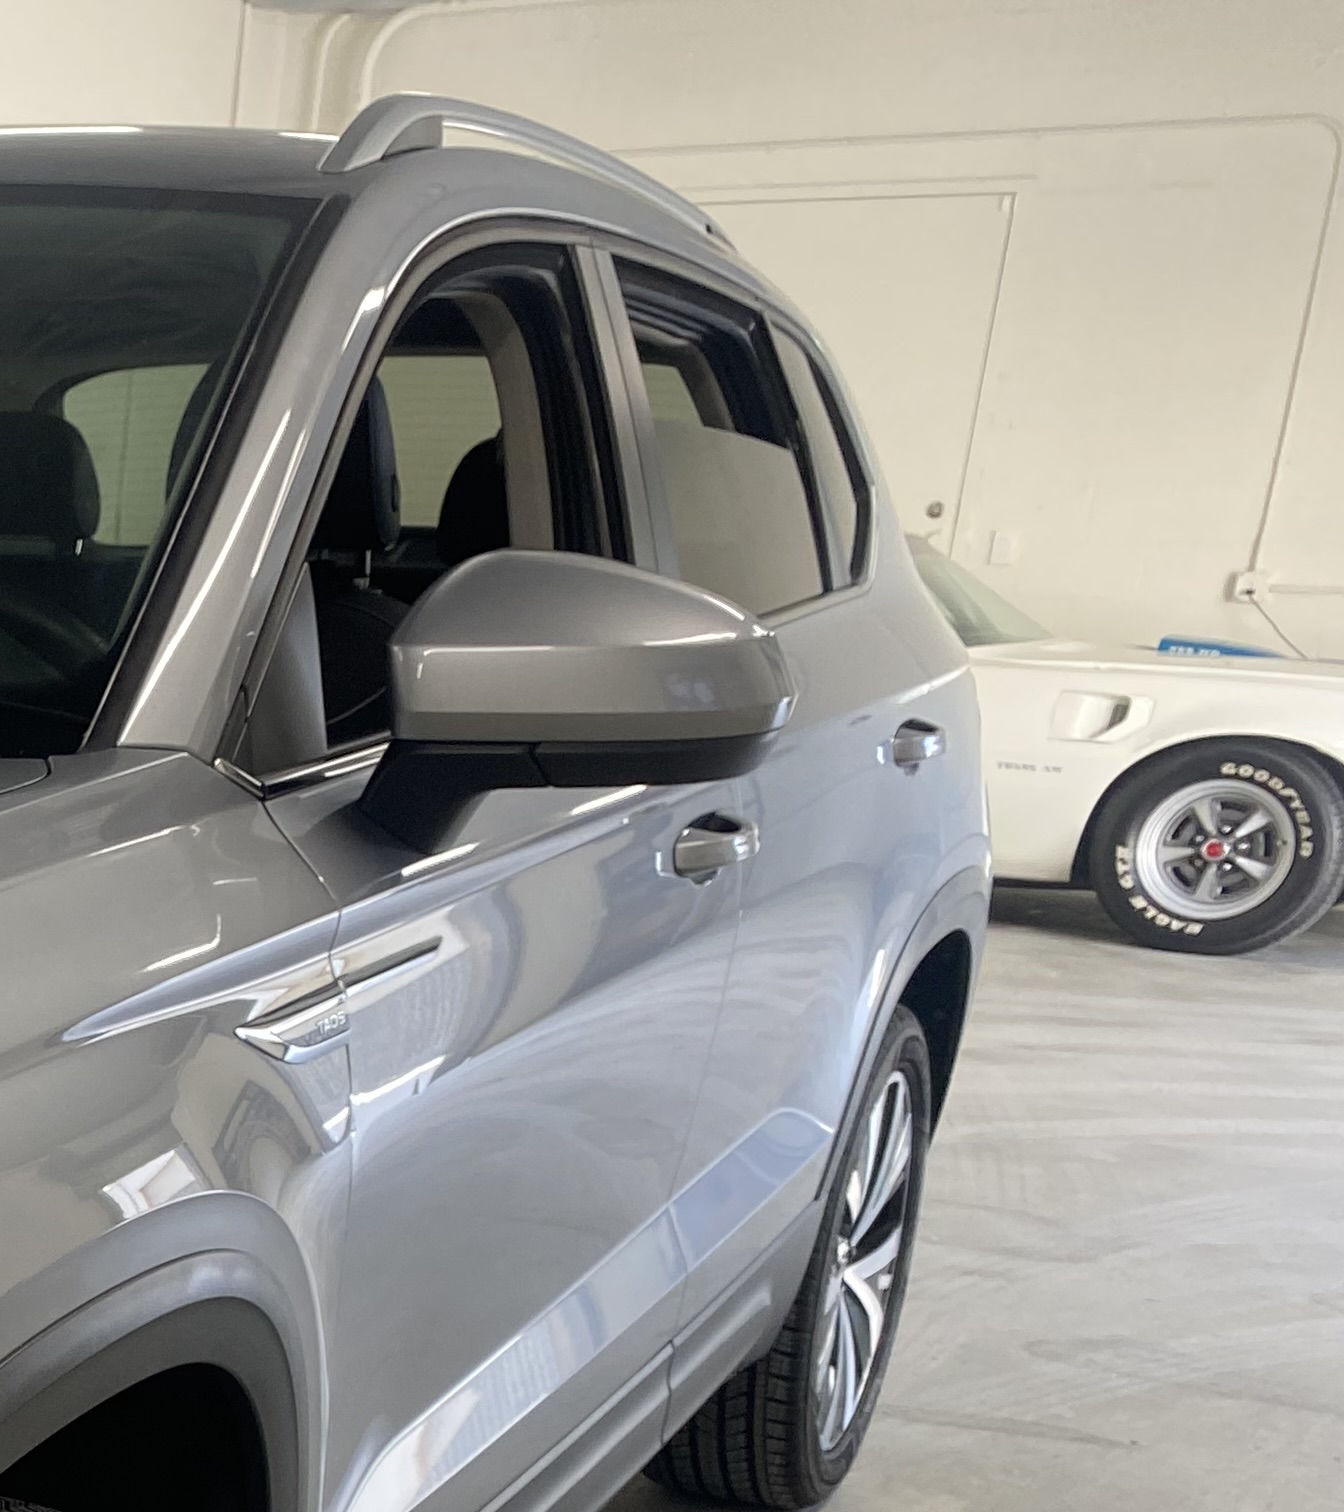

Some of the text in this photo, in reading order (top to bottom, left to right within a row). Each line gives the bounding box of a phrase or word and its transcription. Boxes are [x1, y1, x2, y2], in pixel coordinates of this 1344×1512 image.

[1220, 762, 1313, 859] GOODYEAR
[1128, 895, 1205, 935] EAGLE
[316, 1010, 347, 1035] TAOS
